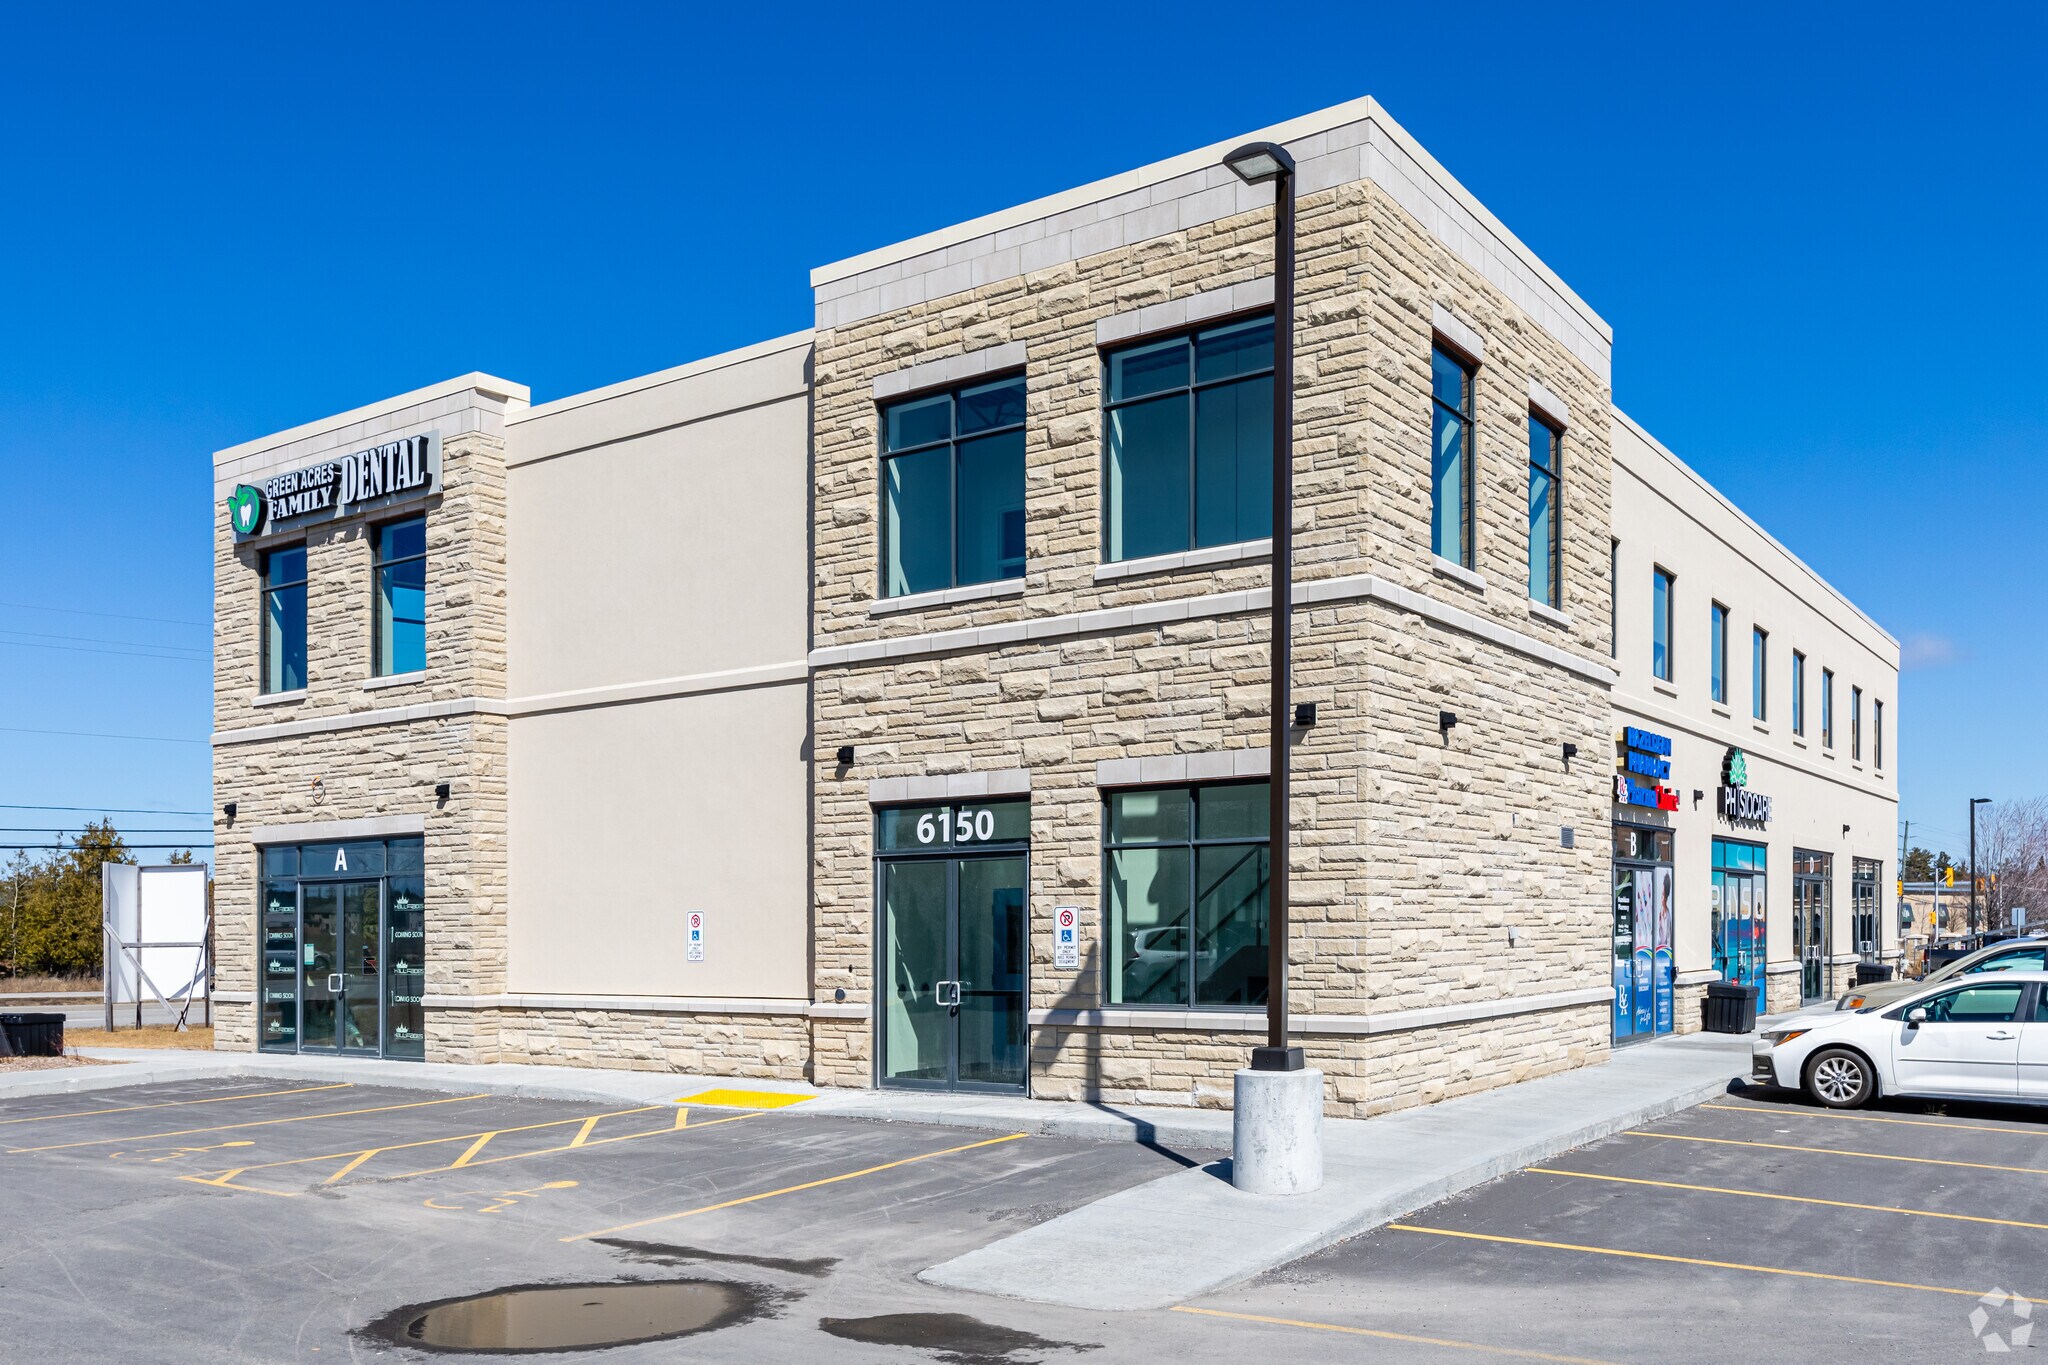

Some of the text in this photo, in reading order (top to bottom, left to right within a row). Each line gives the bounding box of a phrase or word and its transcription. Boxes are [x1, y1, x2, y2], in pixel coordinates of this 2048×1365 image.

[265, 463, 335, 499] GREEN ACRES
[267, 435, 426, 521] FAMILY DENTAL
[916, 808, 994, 844] 6150
[1630, 831, 1637, 857] B
[334, 847, 348, 872] A
